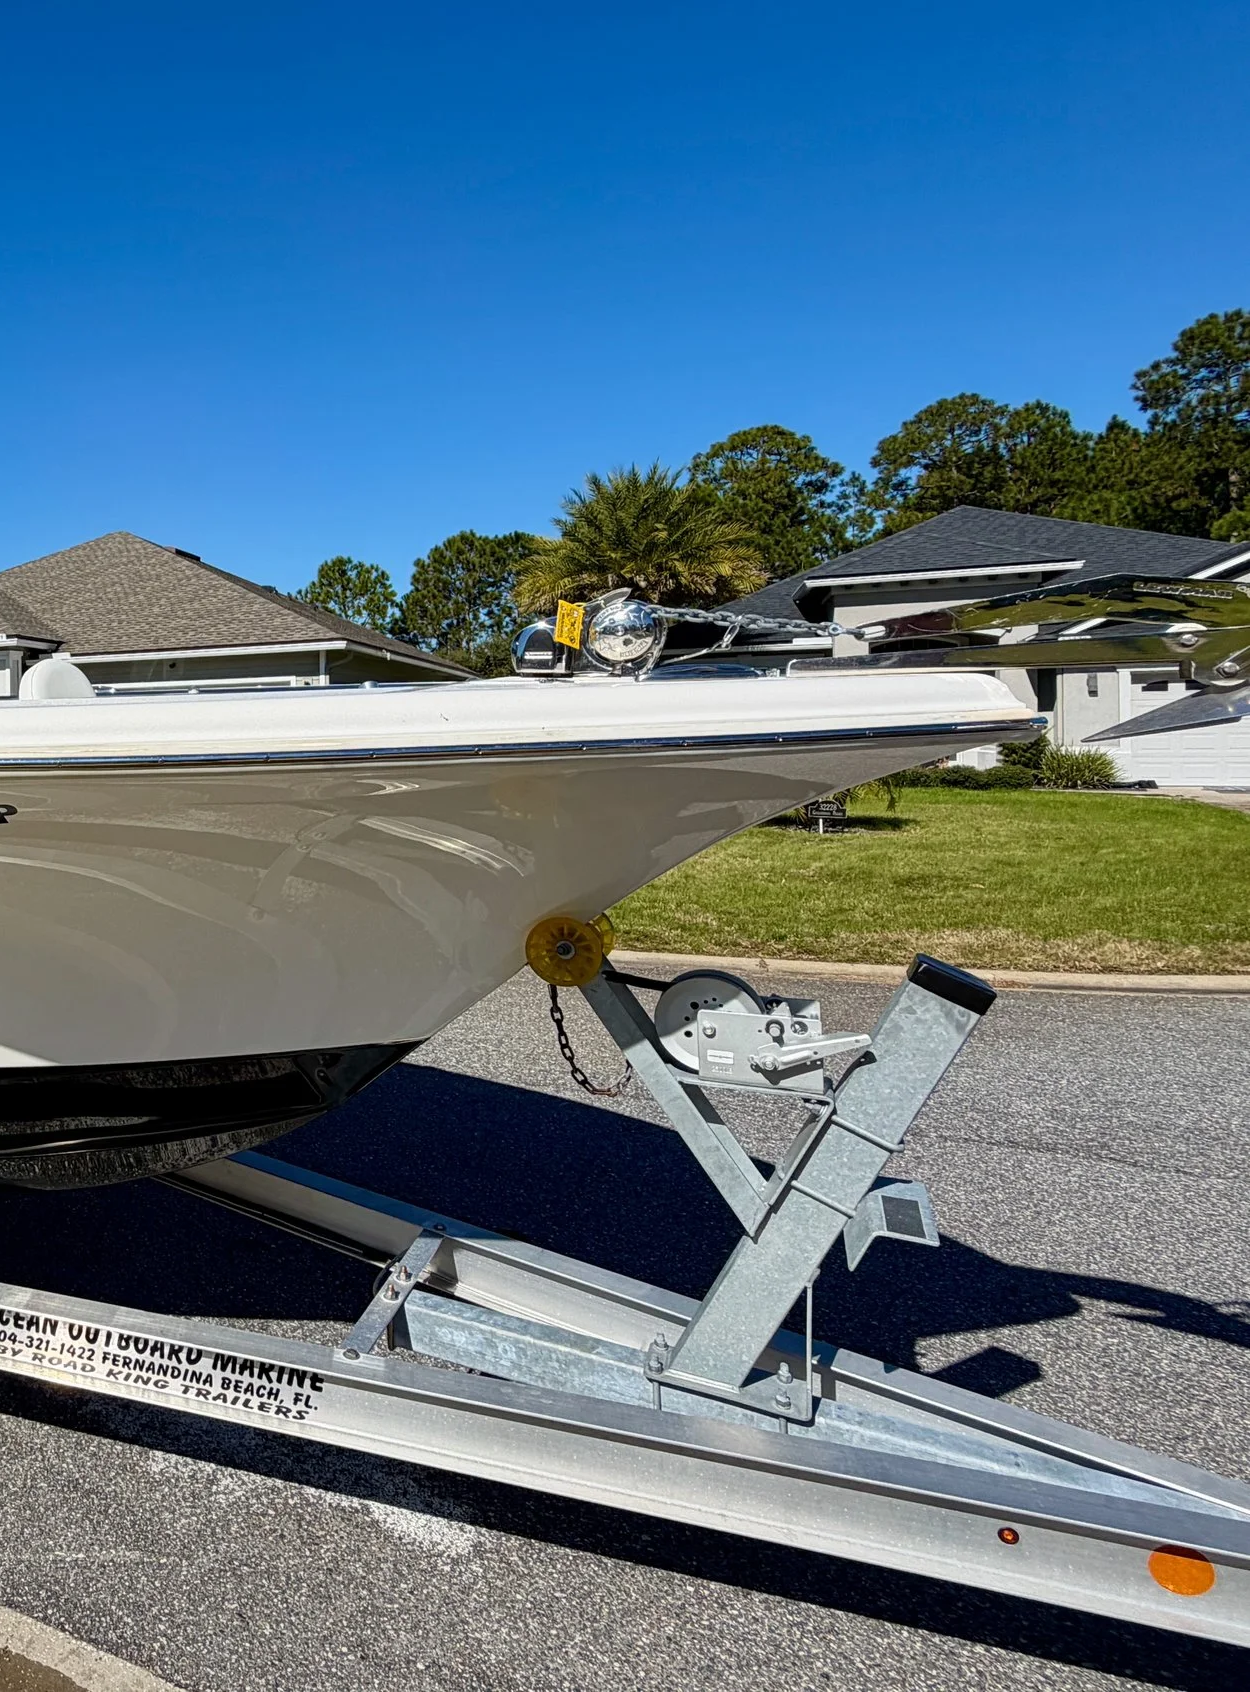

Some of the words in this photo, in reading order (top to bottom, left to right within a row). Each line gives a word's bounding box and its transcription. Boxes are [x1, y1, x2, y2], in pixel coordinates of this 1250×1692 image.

[31, 1352, 96, 1373] ROAD
[105, 1368, 170, 1390] KING
[180, 1384, 310, 1421] TRAILERS
[68, 1322, 203, 1365] OUTBOARD
[212, 1353, 325, 1392] MARINE
[102, 1351, 213, 1388] FERNANDINA
[221, 1376, 284, 1405] BEACH,
[293, 1392, 318, 1410] FL.
